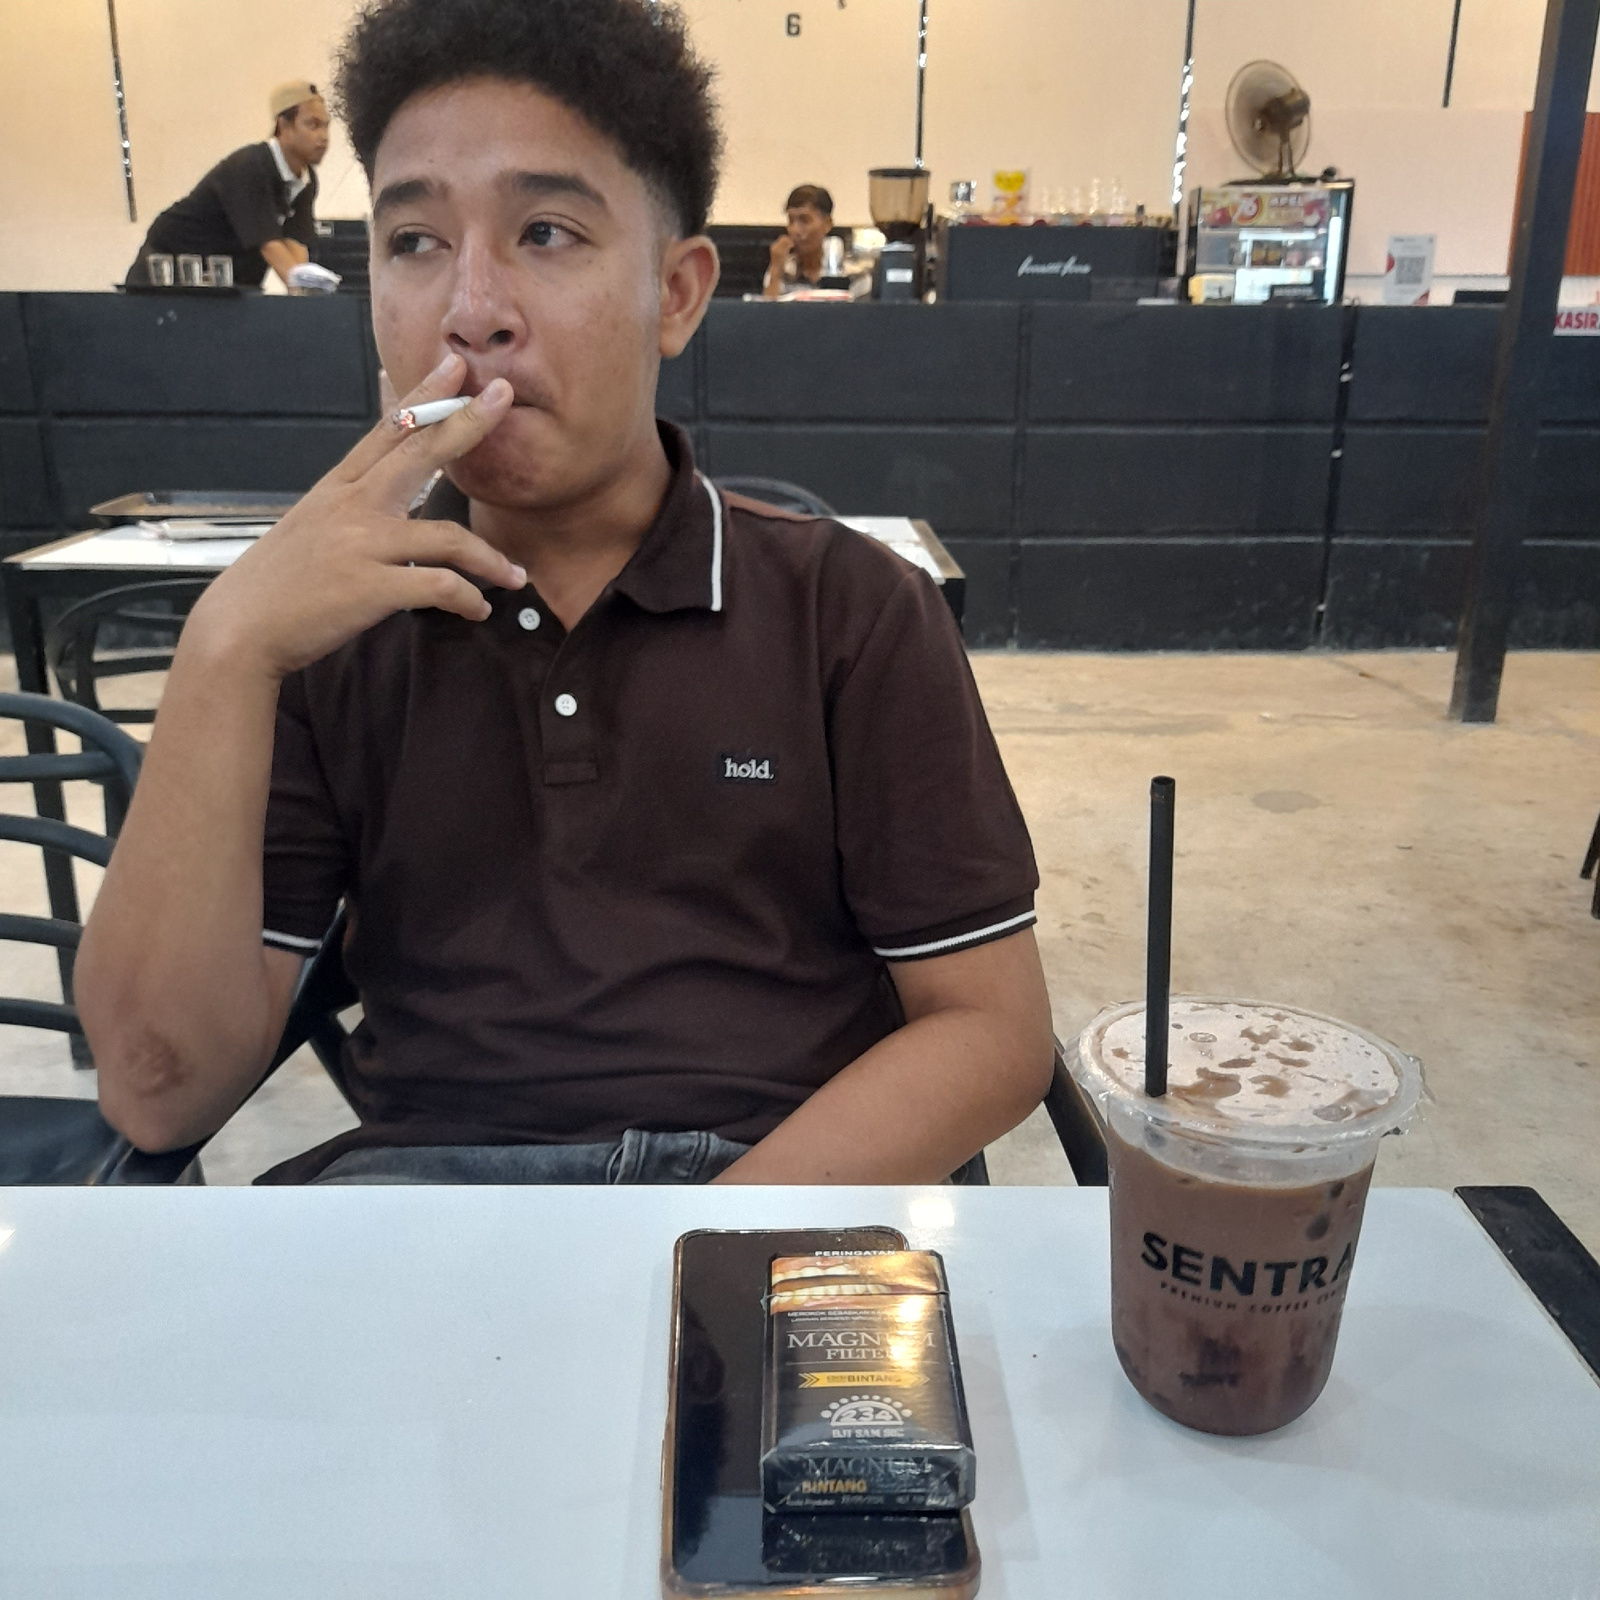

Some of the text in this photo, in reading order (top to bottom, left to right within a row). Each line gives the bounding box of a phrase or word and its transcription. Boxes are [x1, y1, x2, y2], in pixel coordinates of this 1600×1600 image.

[786, 13, 801, 36] 6
[839, 1406, 893, 1422] 234
[801, 1479, 867, 1494] BINTANG
